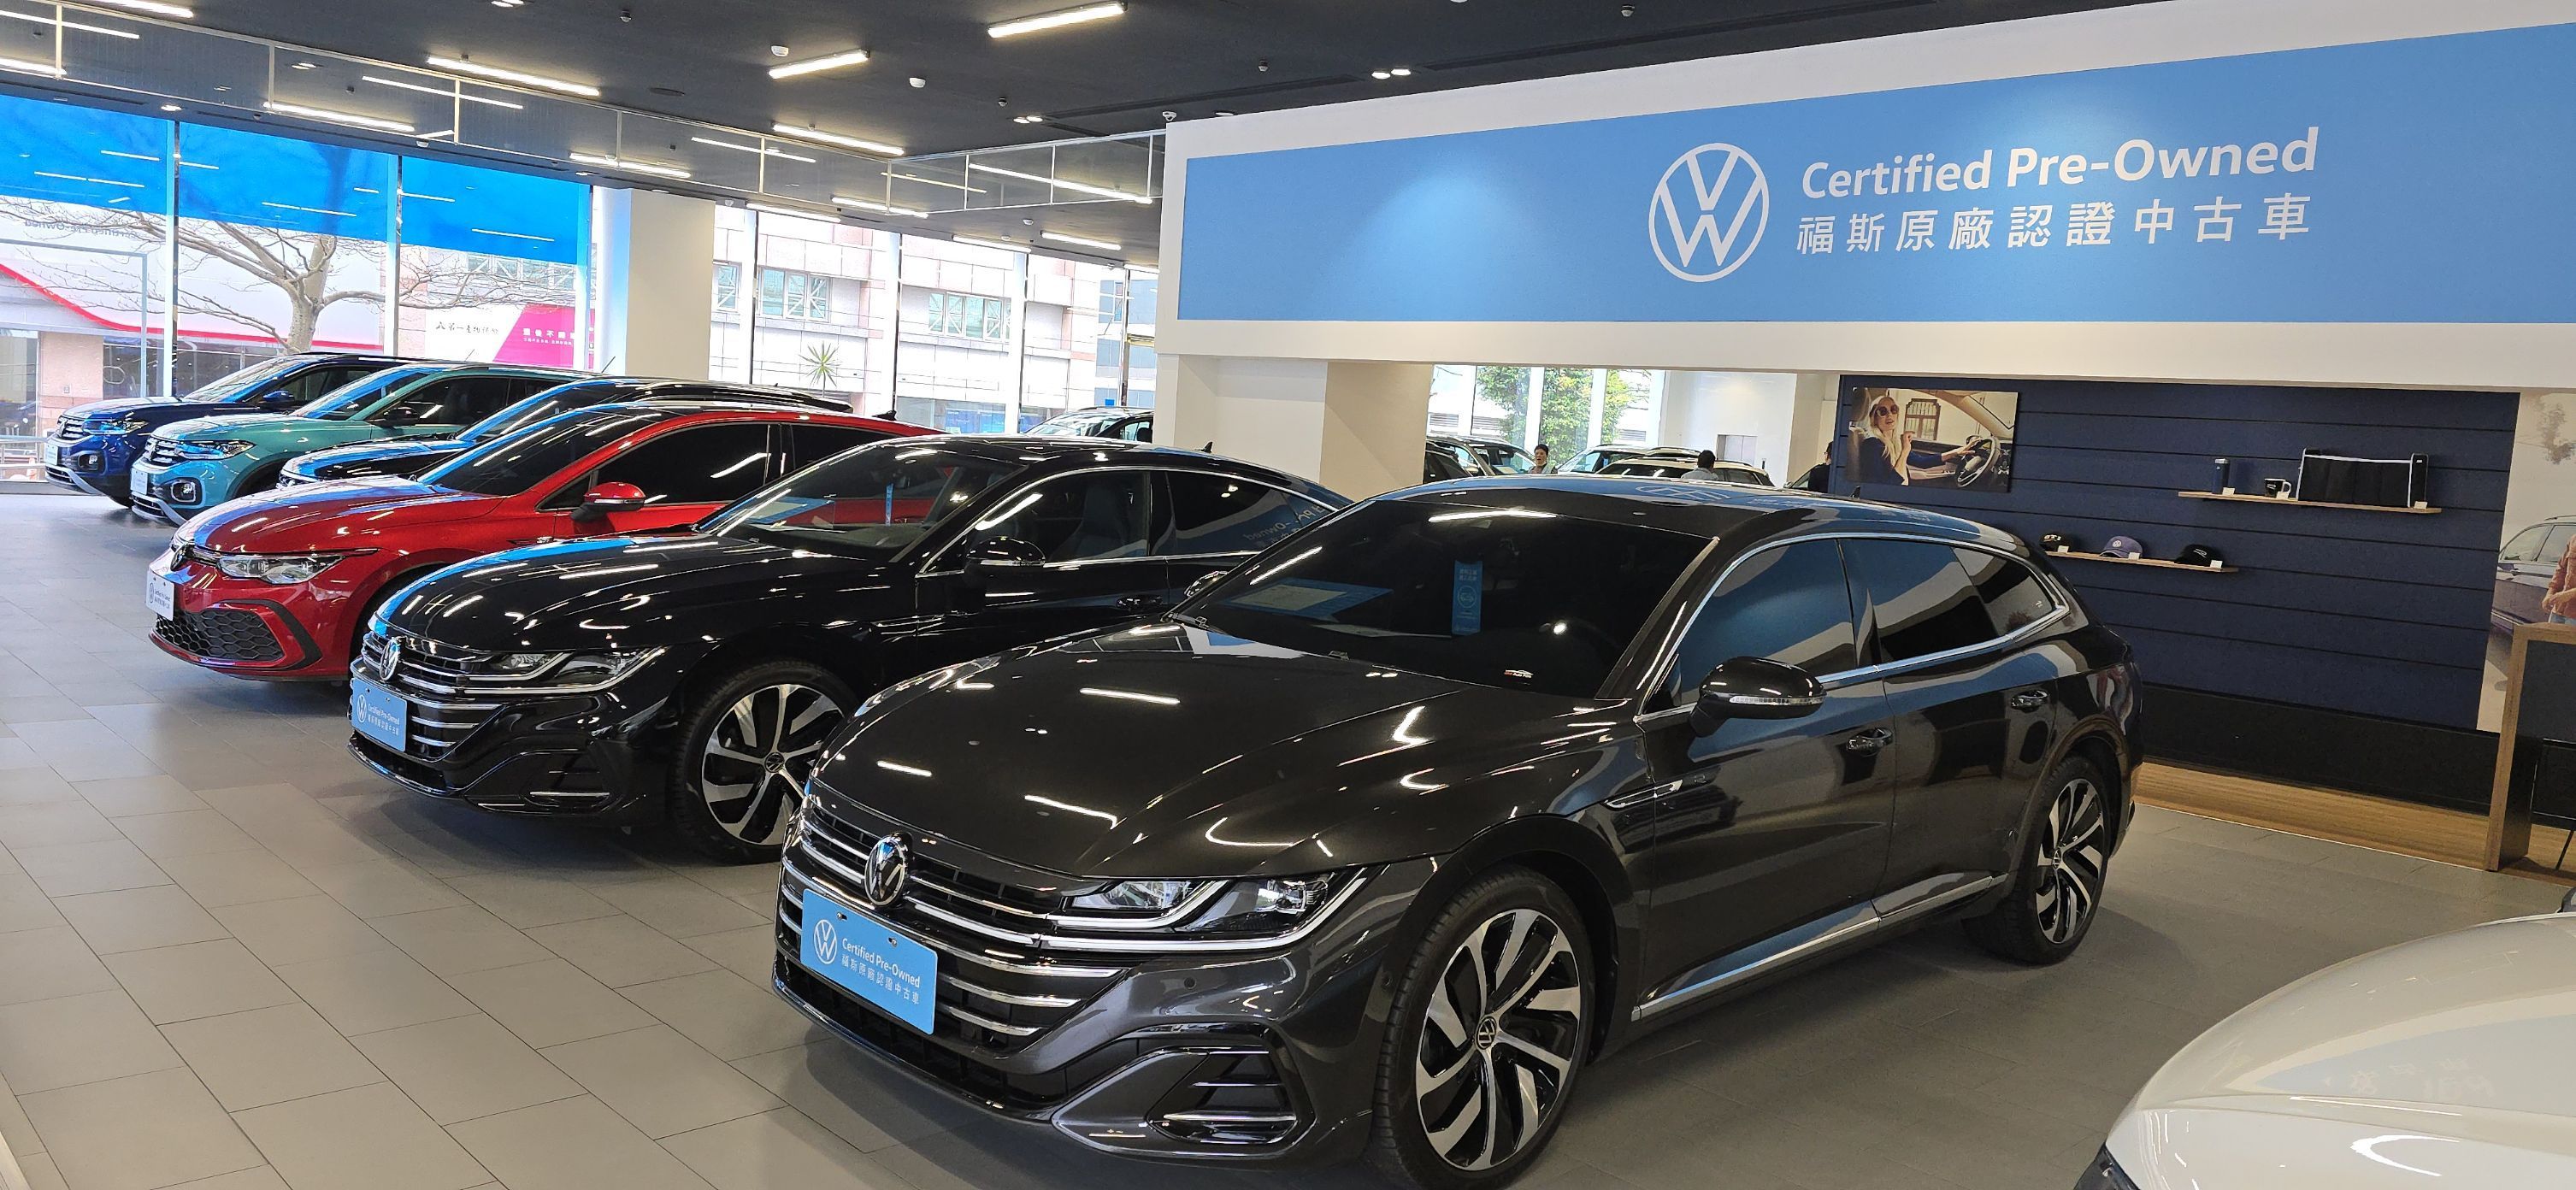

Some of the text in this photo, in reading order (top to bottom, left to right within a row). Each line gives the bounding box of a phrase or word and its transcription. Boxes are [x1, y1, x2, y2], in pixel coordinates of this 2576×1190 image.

[1802, 126, 2320, 199] Certified Pre-Owned
[1648, 142, 1770, 283] VW
[1796, 192, 2311, 255] 福斯原廠認證中古車
[814, 919, 838, 964] VW
[842, 938, 921, 988] Certified Pre-Owned
